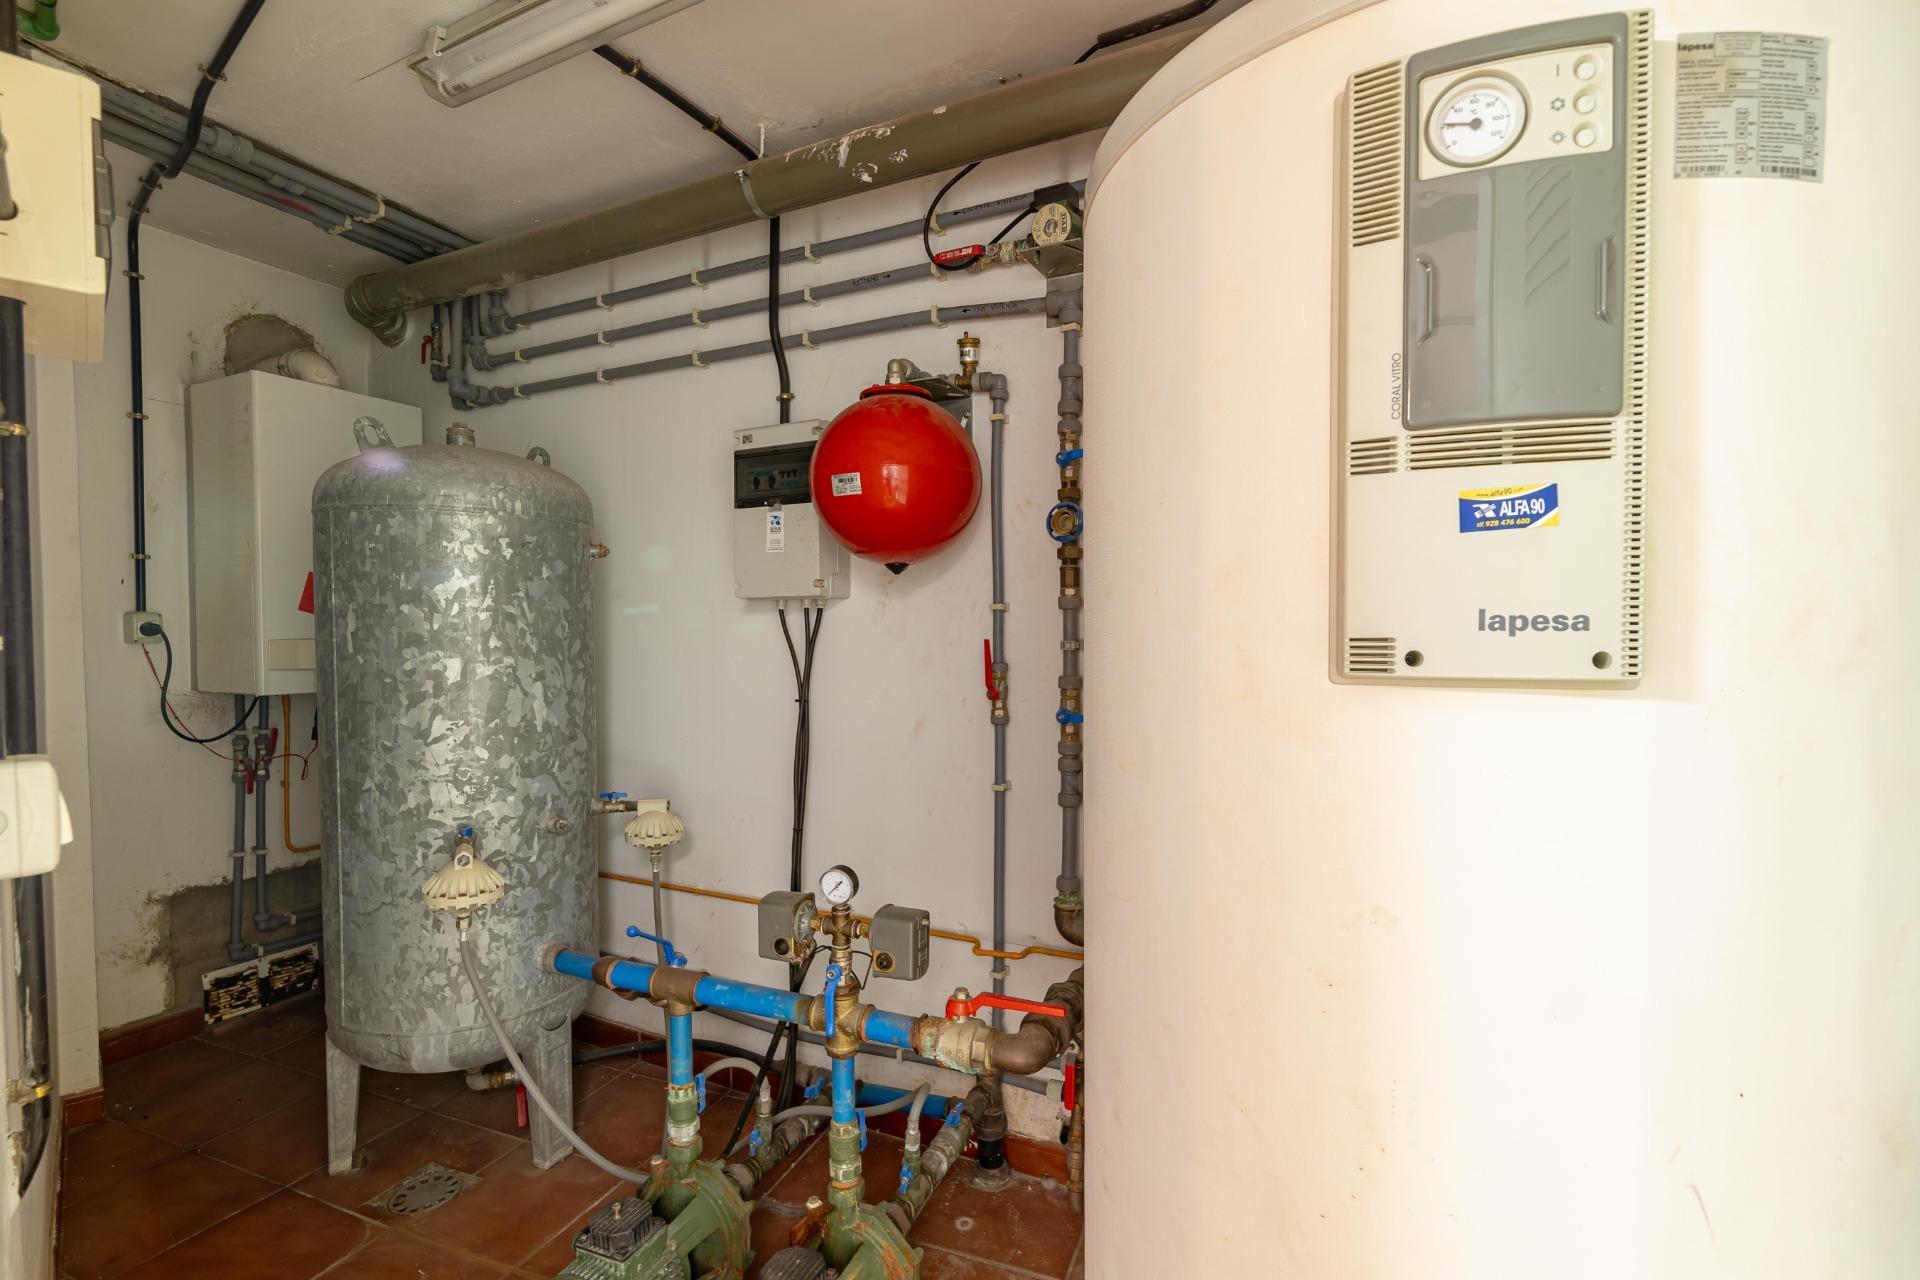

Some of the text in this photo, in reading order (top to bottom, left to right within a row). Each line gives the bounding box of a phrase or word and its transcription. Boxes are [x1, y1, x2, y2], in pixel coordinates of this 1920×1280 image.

[1678, 43, 1714, 52] lapesa
[1391, 353, 1401, 420] CORAL VITRO
[1478, 608, 1590, 637] lapesa
